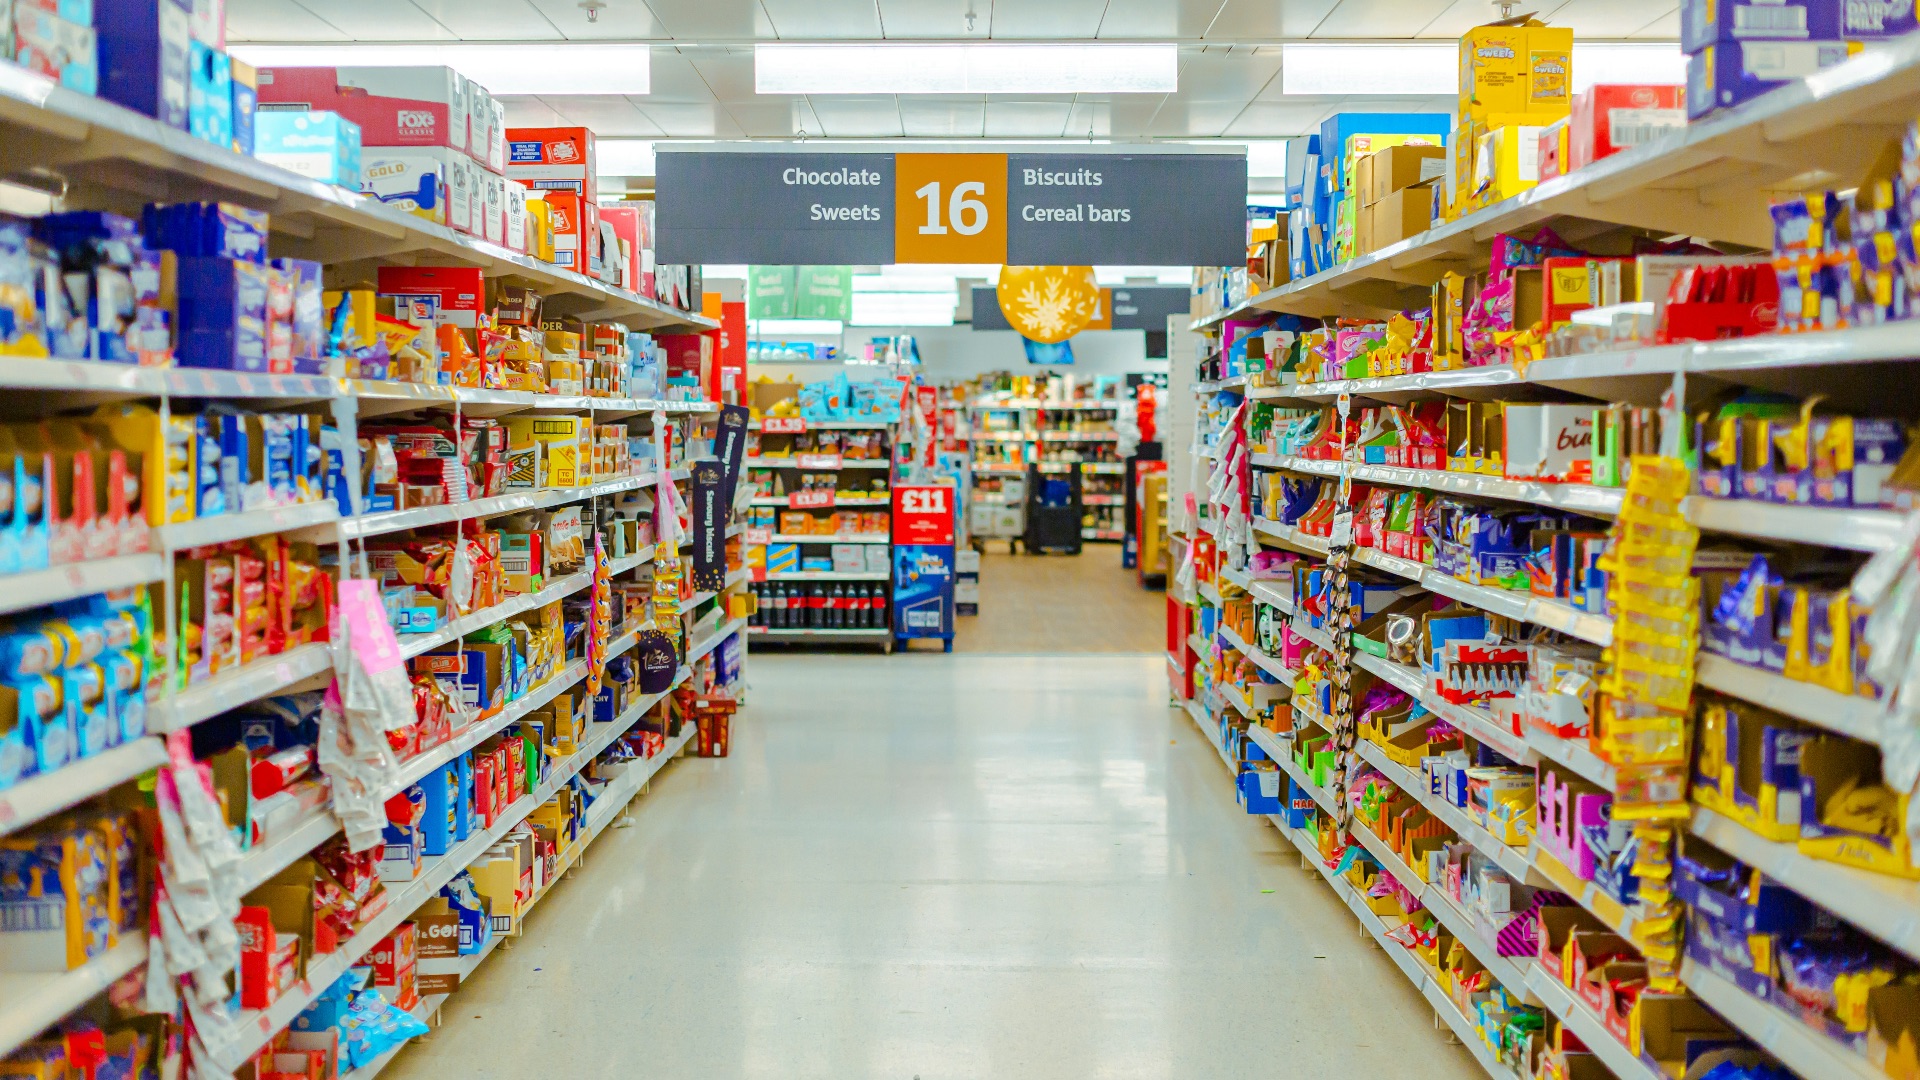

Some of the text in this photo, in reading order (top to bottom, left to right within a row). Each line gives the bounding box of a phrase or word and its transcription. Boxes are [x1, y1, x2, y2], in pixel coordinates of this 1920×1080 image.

[369, 164, 404, 177] GOLD
[783, 168, 881, 186] Chocolate
[1023, 168, 1103, 186] Biscuits
[810, 204, 881, 221] Sweets
[915, 181, 989, 236] 16
[1022, 204, 1131, 222] Cereal bars
[706, 490, 716, 526] Savoury
[901, 489, 947, 514] £11
[705, 528, 715, 563] biscuits
[432, 659, 450, 669] CLUB
[428, 924, 458, 938] GO!
